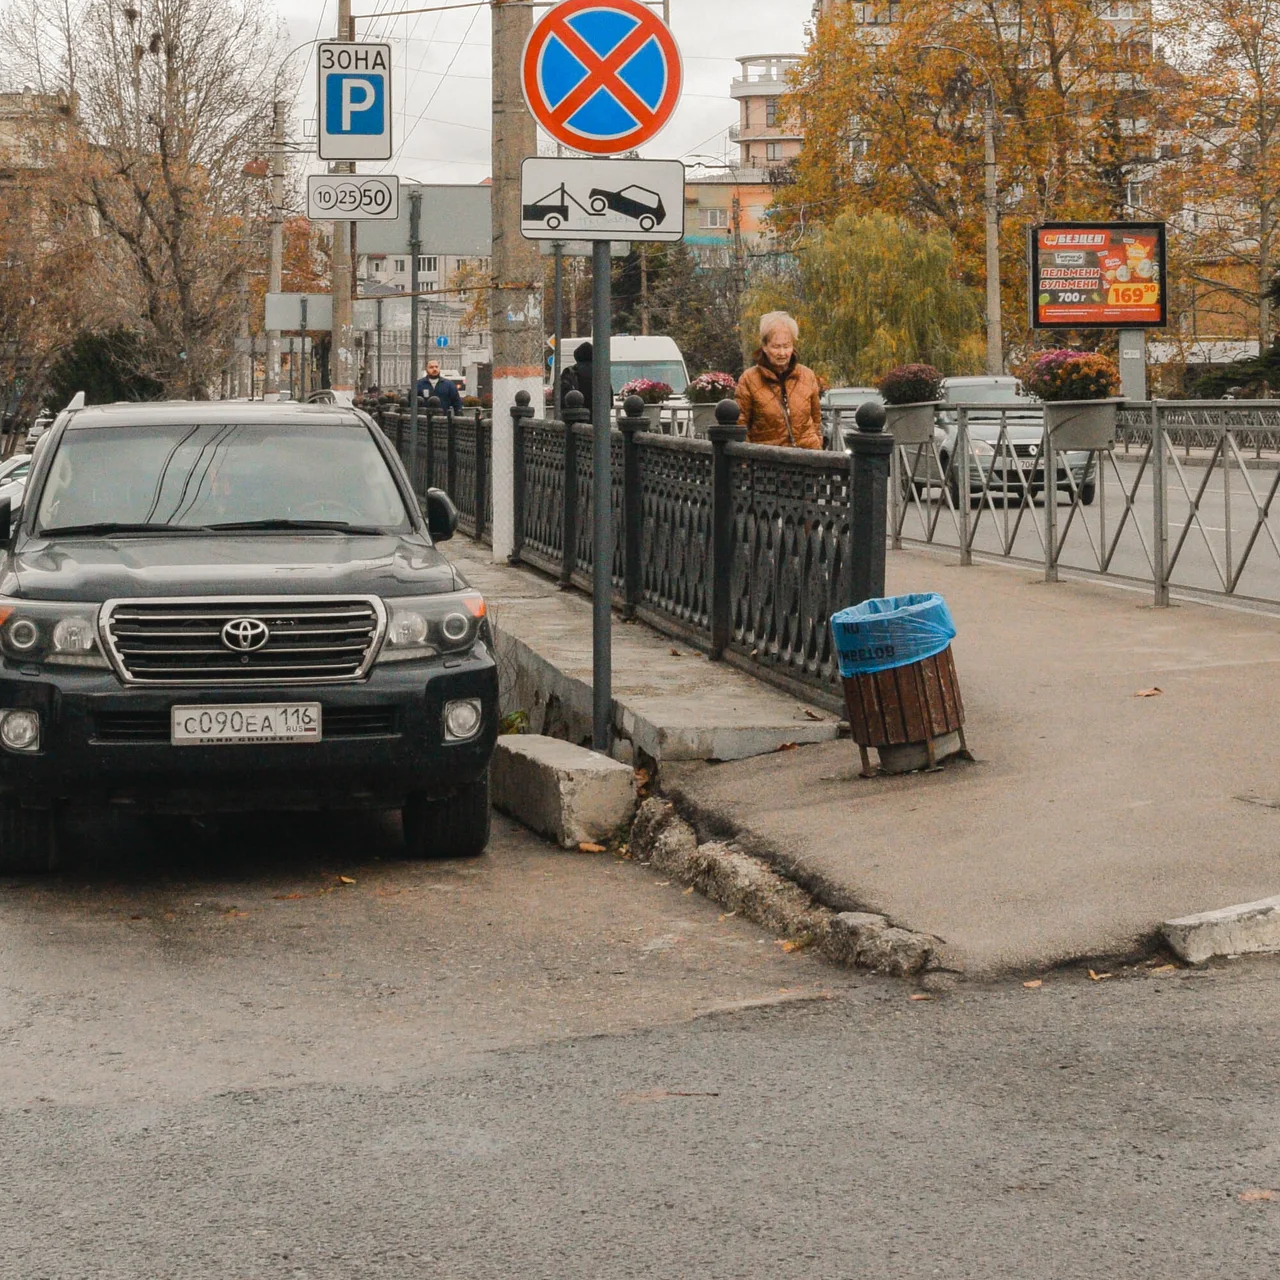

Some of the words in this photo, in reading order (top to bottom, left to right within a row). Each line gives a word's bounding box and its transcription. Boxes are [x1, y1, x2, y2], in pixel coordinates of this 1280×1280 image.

[322, 50, 386, 70] ЗОНА
[341, 78, 376, 131] P
[318, 191, 331, 203] 10
[338, 190, 357, 204] 25
[363, 189, 386, 206] 50
[1041, 268, 1100, 278] ПЕЛЬМЕНИ
[1040, 280, 1098, 289] БУЛЬМЕНИ
[1058, 293, 1080, 302] 700
[1112, 288, 1144, 303] 169
[1144, 285, 1156, 293] 90
[184, 710, 274, 734] С090ЕА
[279, 707, 312, 725] 116
